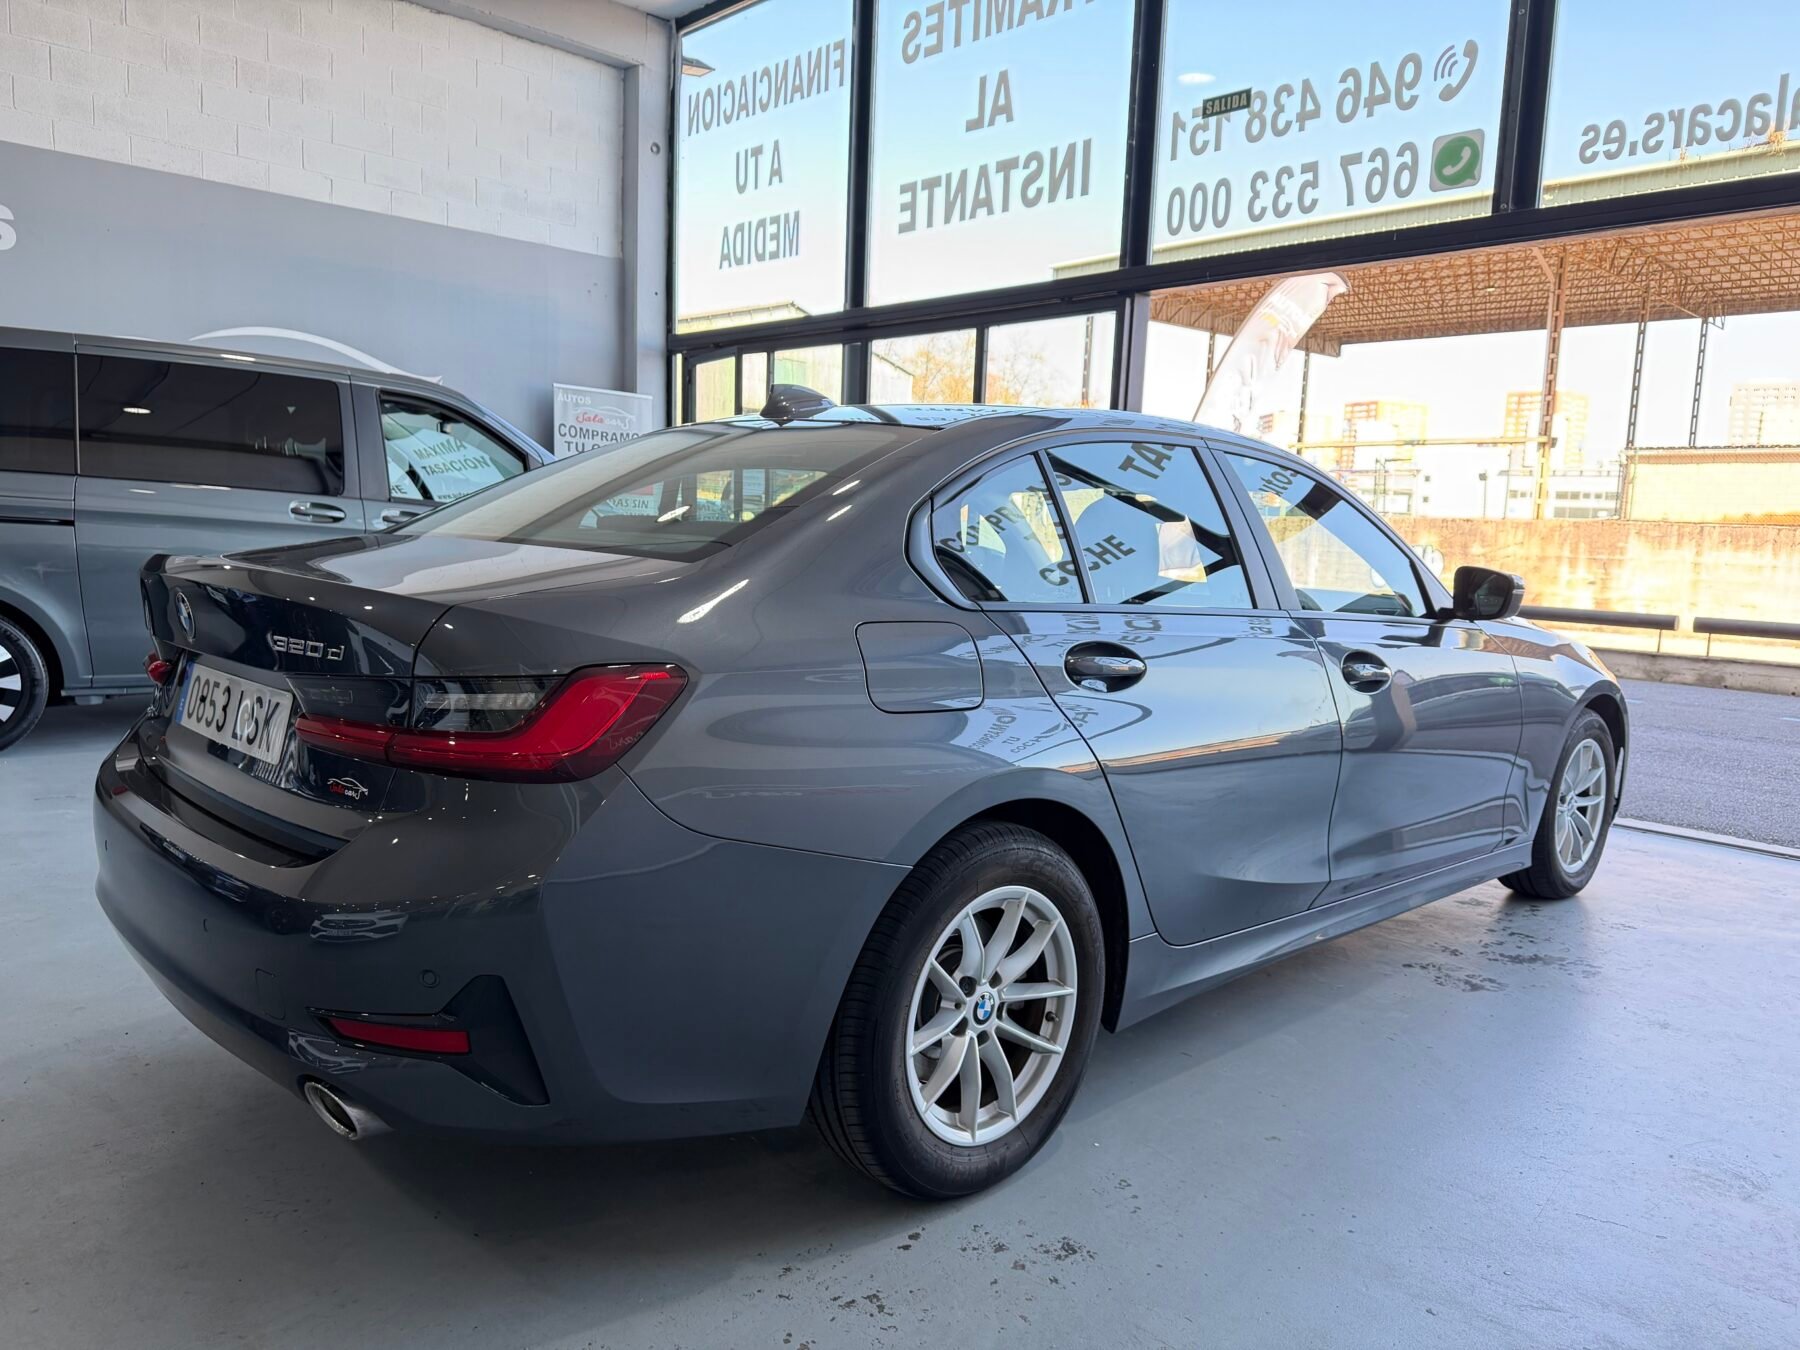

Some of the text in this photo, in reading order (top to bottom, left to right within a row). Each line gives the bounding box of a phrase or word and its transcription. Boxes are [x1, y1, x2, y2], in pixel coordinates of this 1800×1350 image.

[1205, 92, 1248, 115] SALIDA
[557, 390, 592, 405] AUTOS
[558, 423, 640, 444] COMPRAMO
[187, 675, 232, 732] 0853
